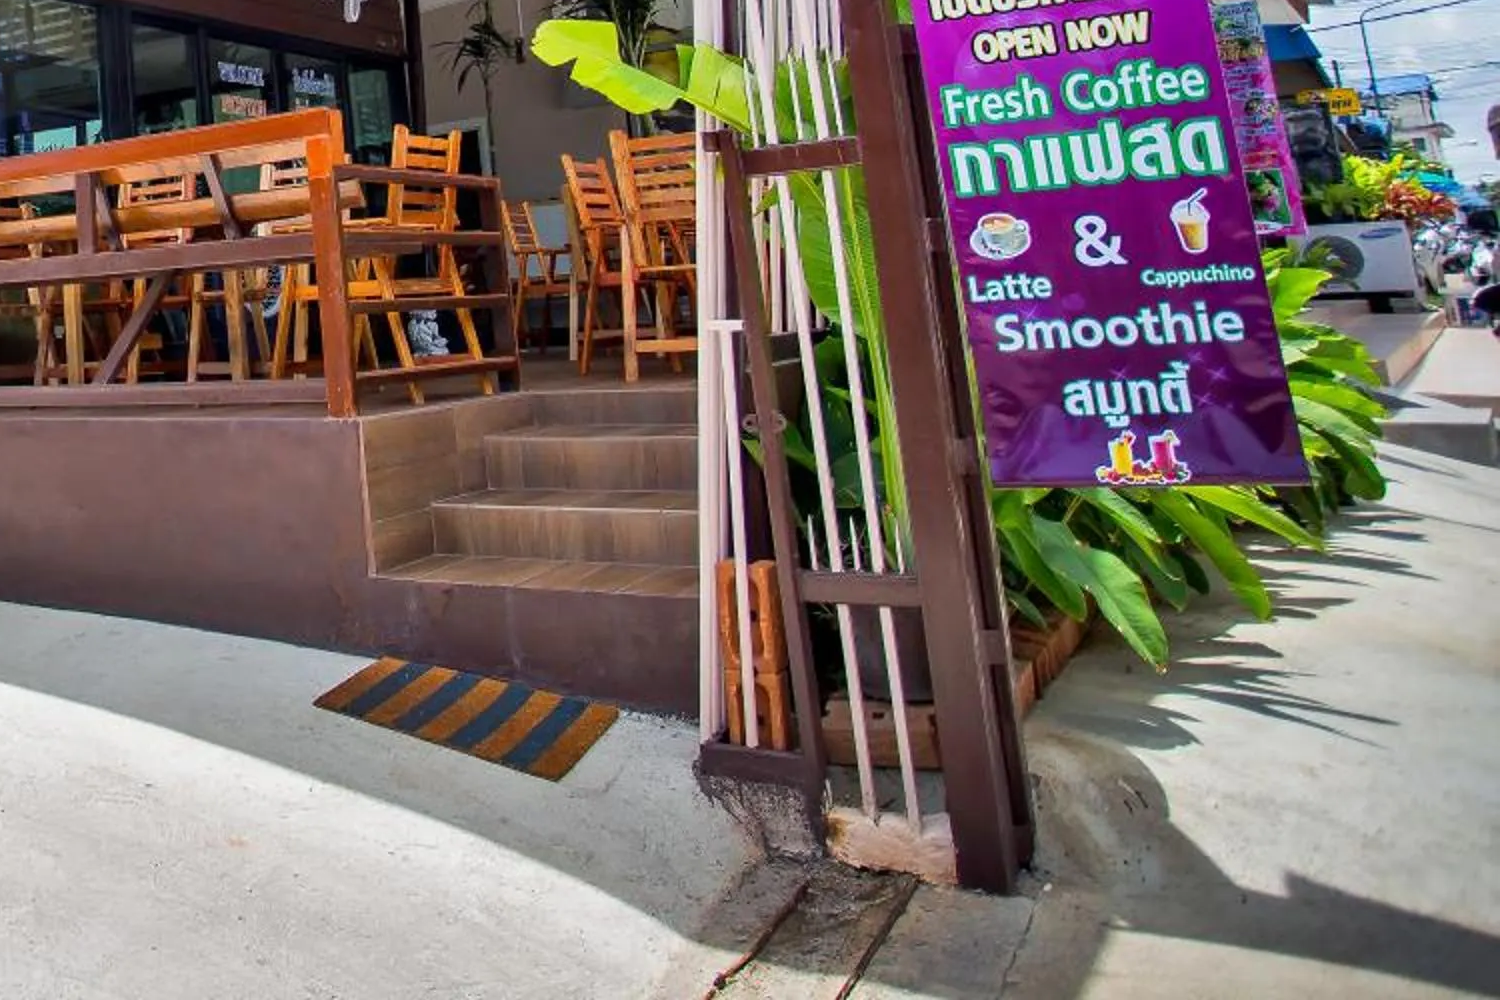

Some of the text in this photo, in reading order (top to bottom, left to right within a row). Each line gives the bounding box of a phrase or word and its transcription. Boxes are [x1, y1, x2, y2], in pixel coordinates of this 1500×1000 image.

[973, 11, 1150, 63] OPEN NOW
[942, 77, 1052, 126] Fresh
[1064, 60, 1208, 110] Coffee
[950, 118, 1229, 197] กาแฟสด
[1073, 214, 1129, 268] &
[967, 272, 1053, 304] Latte
[1139, 263, 1256, 289] Cappuchino
[995, 301, 1245, 352] Smoothie
[1062, 362, 1194, 430] สมูทตี้
